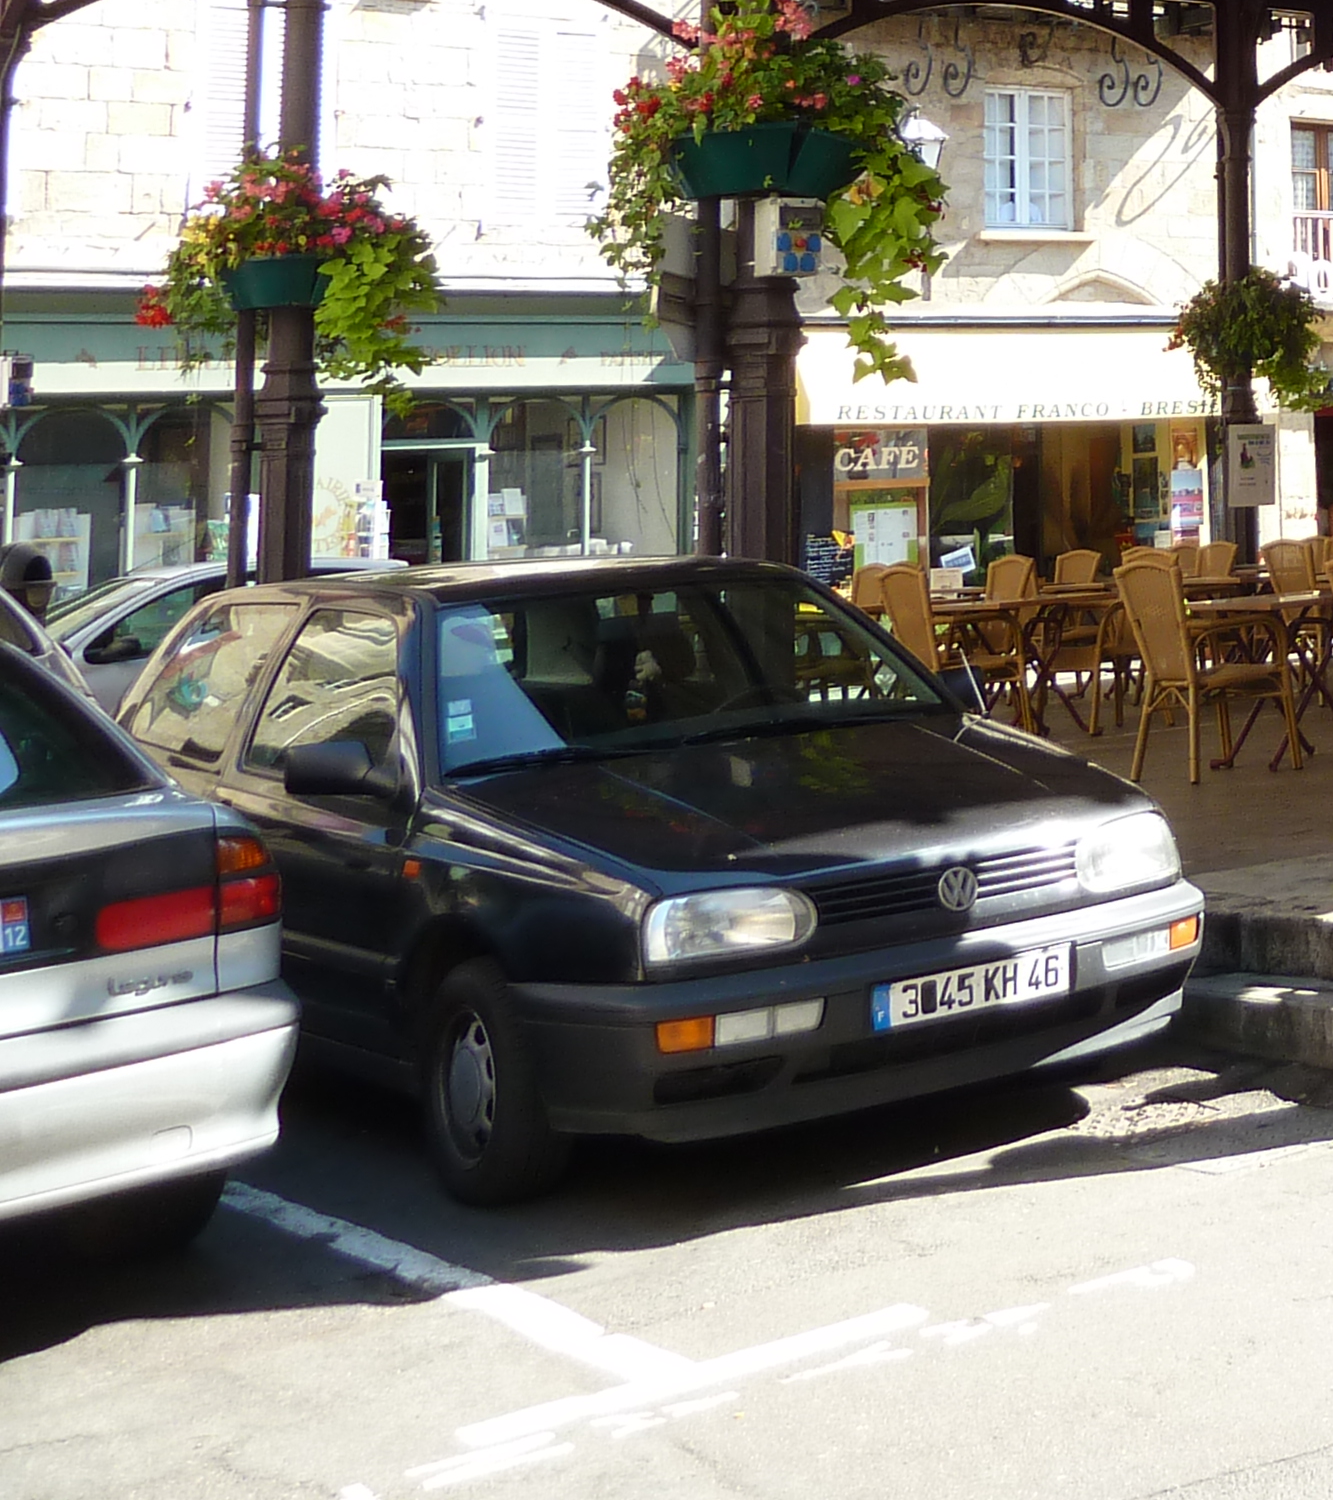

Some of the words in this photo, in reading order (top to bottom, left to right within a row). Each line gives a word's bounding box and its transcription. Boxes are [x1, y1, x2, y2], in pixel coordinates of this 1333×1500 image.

[837, 405, 1003, 421] RESTAURANT
[1016, 403, 1110, 419] FRANCO
[834, 441, 919, 472] CAFÉ
[4, 925, 27, 947] 12
[984, 962, 1018, 1002] KH
[1028, 954, 1059, 991] 46
[877, 1012, 885, 1022] F
